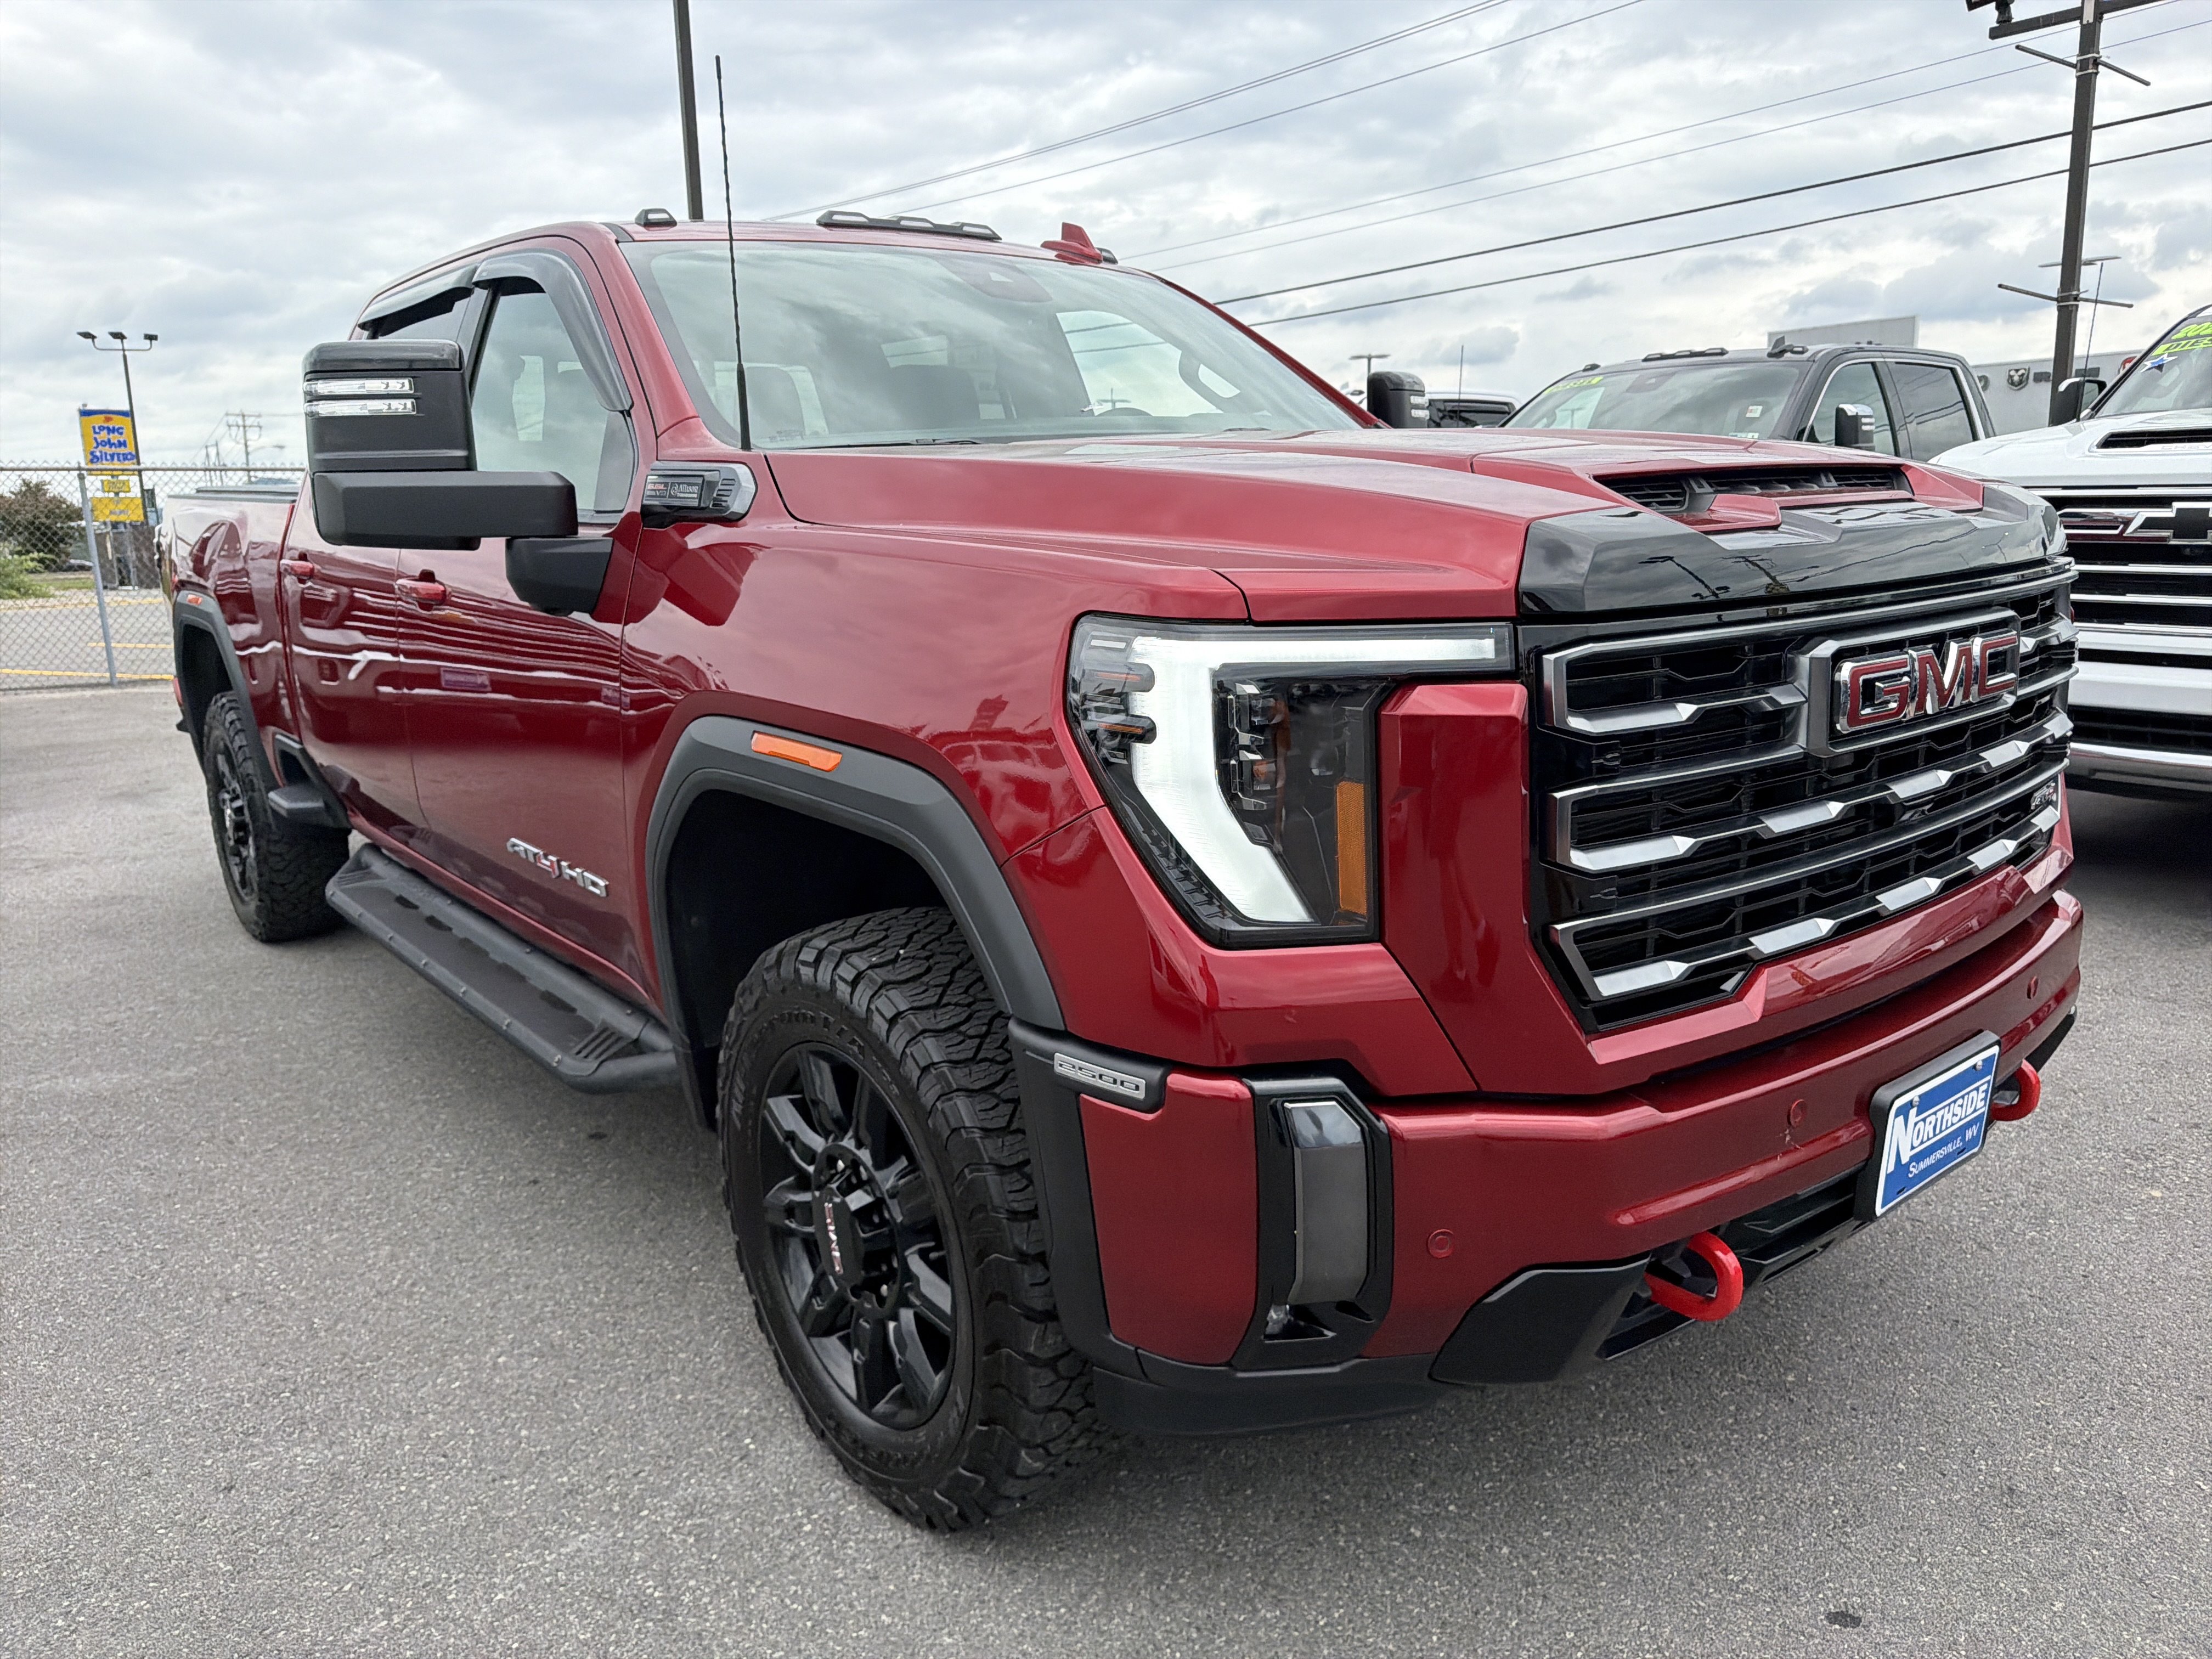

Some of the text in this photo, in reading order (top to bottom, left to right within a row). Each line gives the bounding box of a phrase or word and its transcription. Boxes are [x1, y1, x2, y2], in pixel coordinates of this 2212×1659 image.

[678, 484, 698, 493] Allison
[1838, 629, 2018, 734] GMC
[1058, 1060, 1140, 1093] 2500
[1887, 1083, 1989, 1174] NORTHSIDE
[1965, 1122, 1980, 1141] WV
